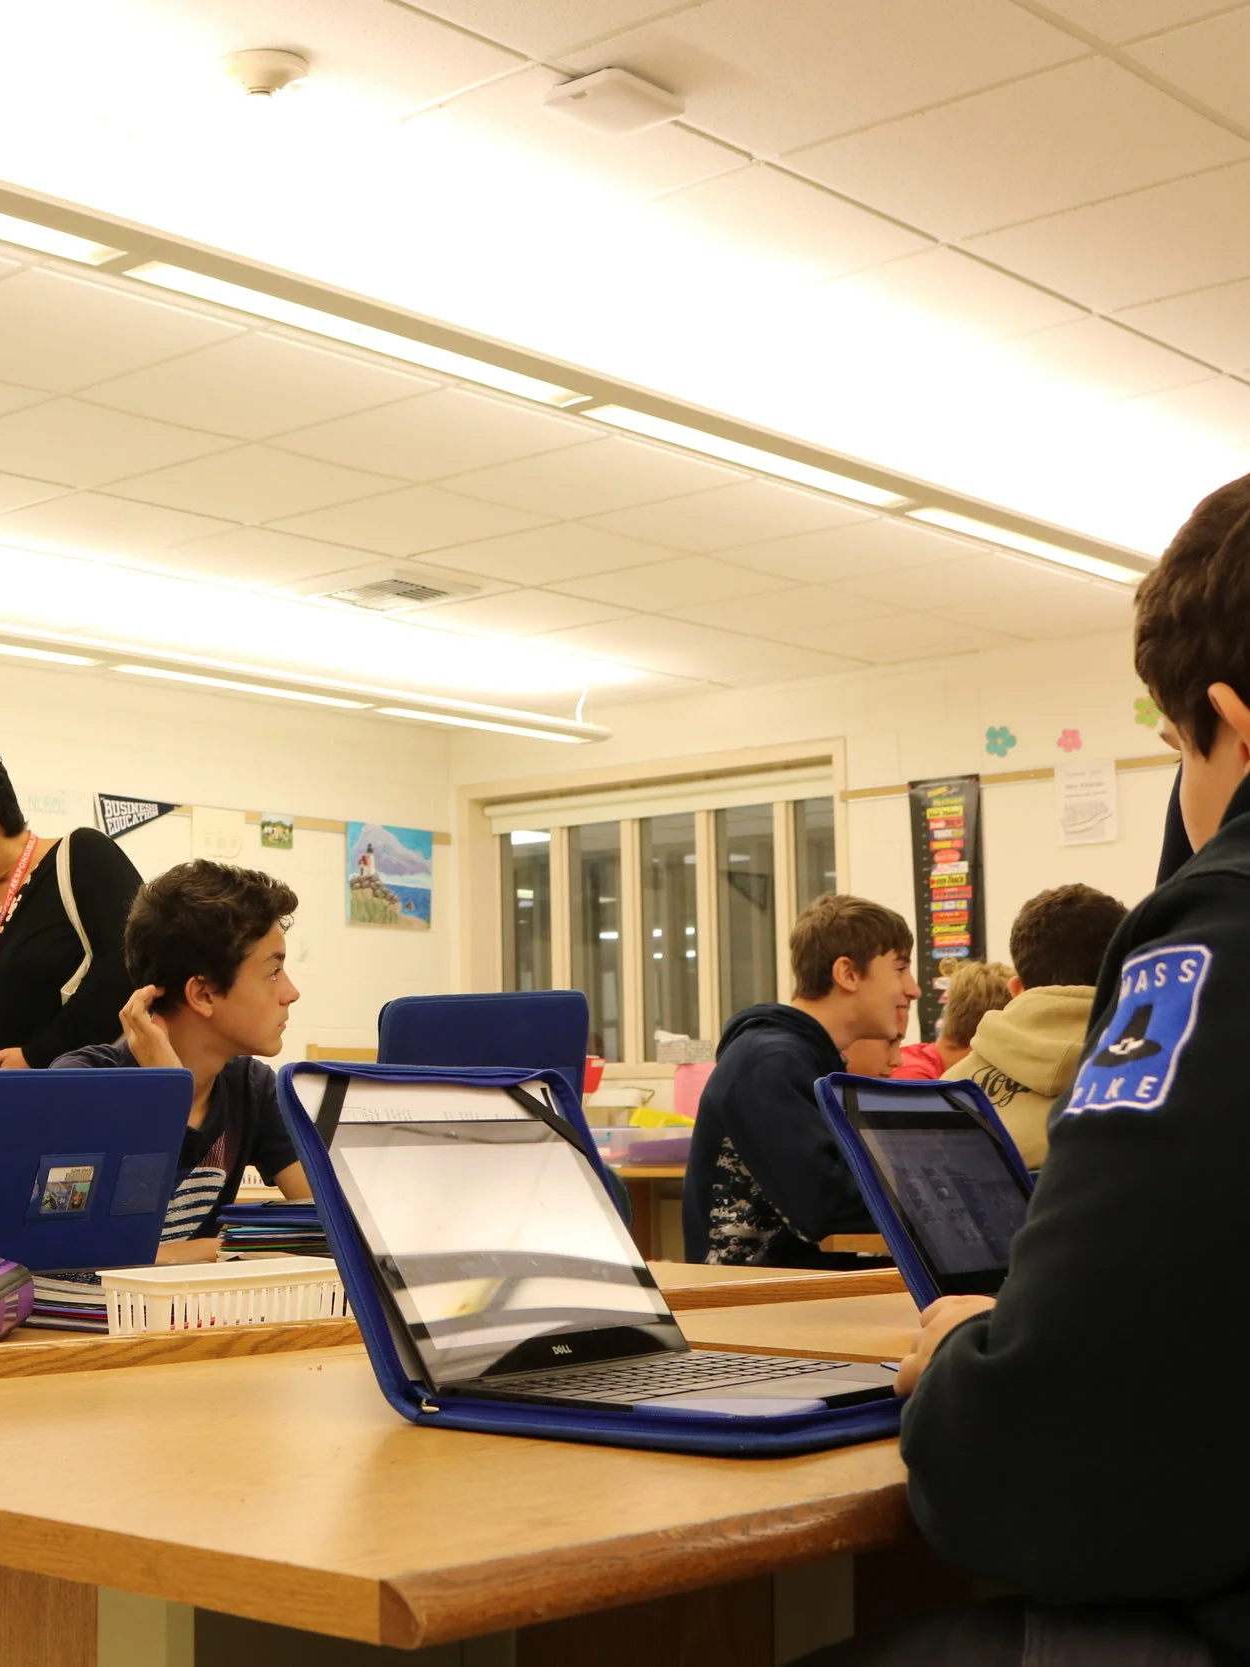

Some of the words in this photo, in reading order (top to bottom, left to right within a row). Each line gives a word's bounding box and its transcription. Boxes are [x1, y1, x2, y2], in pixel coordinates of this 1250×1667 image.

[103, 800, 158, 818] BUSINESS
[106, 808, 159, 836] EDUCATION
[551, 1344, 573, 1355] DELL
